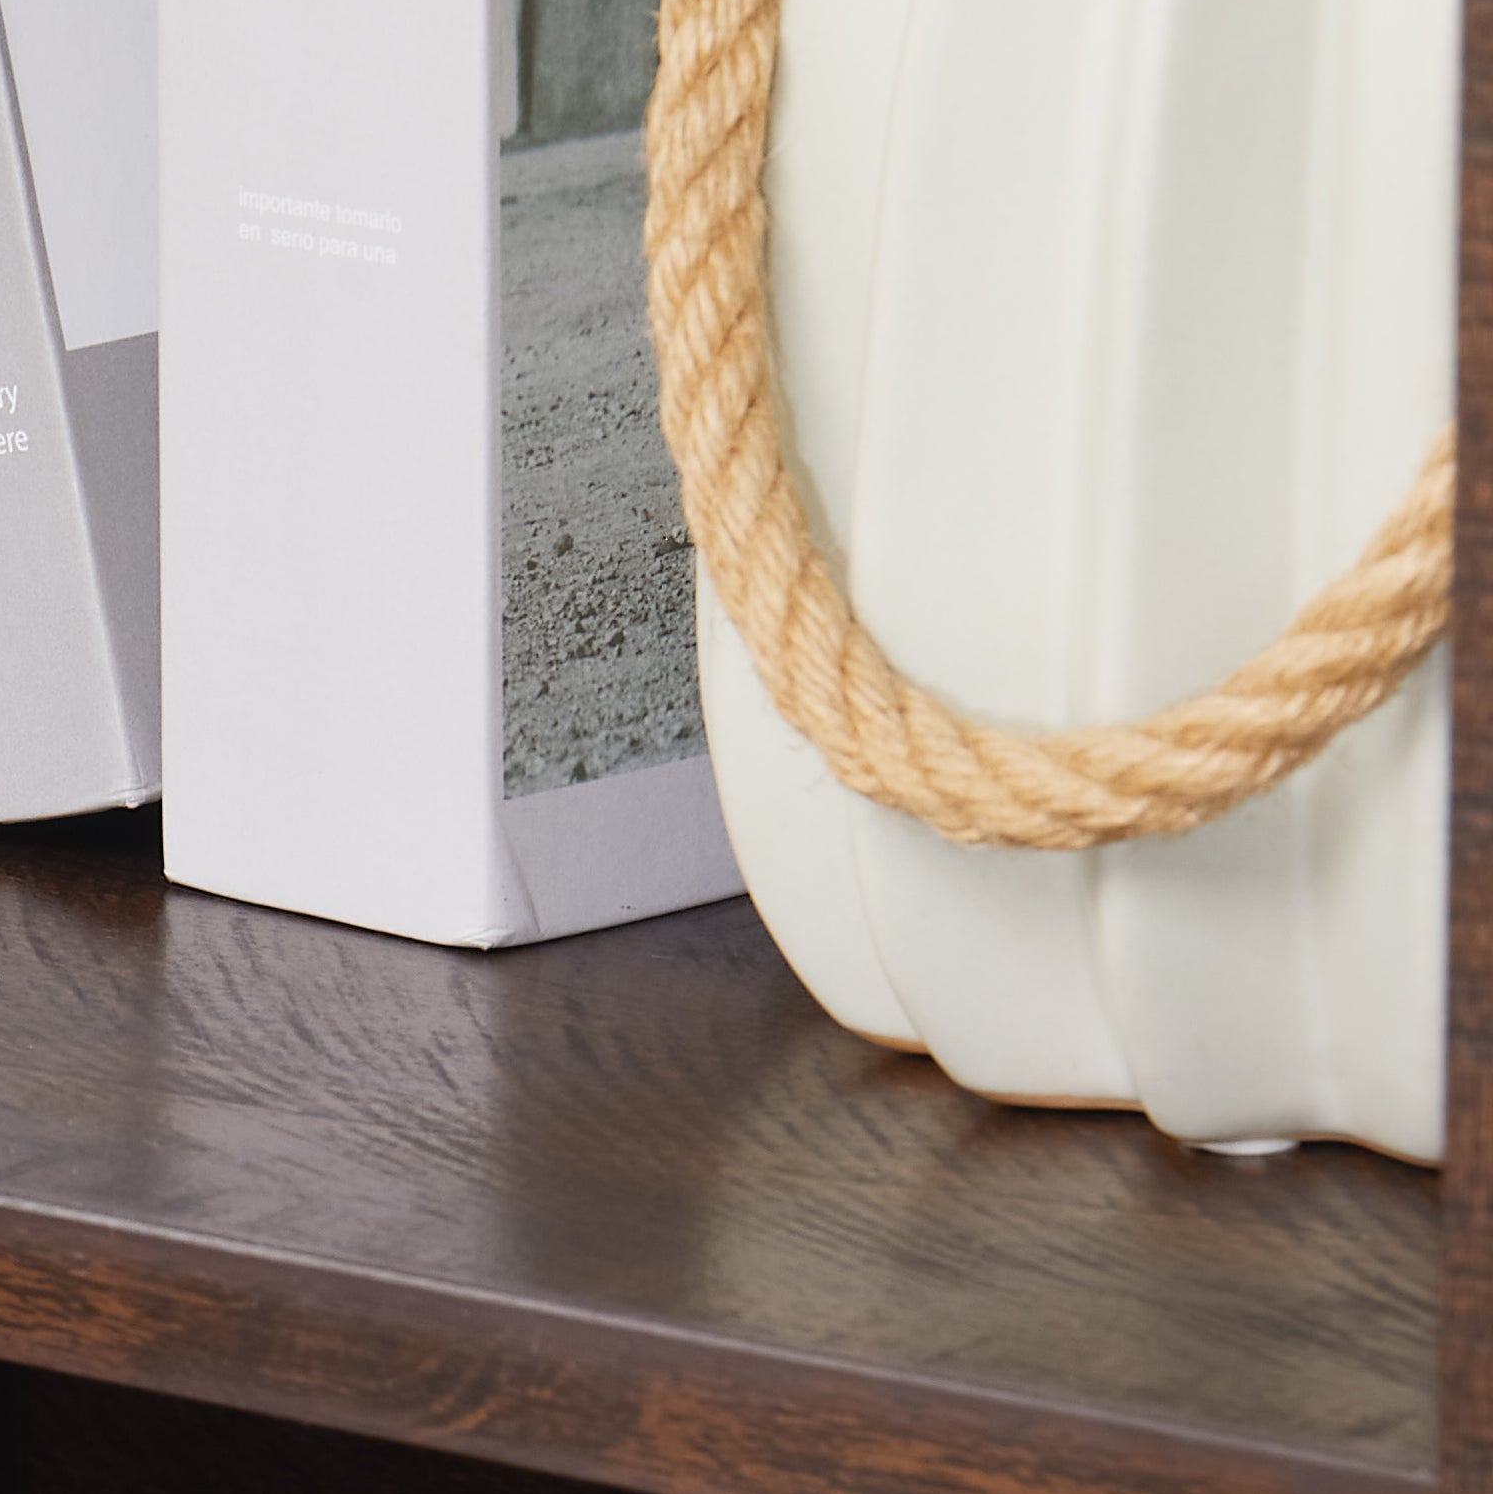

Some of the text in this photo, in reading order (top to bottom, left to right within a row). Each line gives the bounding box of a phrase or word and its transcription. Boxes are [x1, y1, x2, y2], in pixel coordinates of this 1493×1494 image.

[237, 186, 331, 222] importante
[238, 221, 261, 242] en
[362, 242, 397, 265] una
